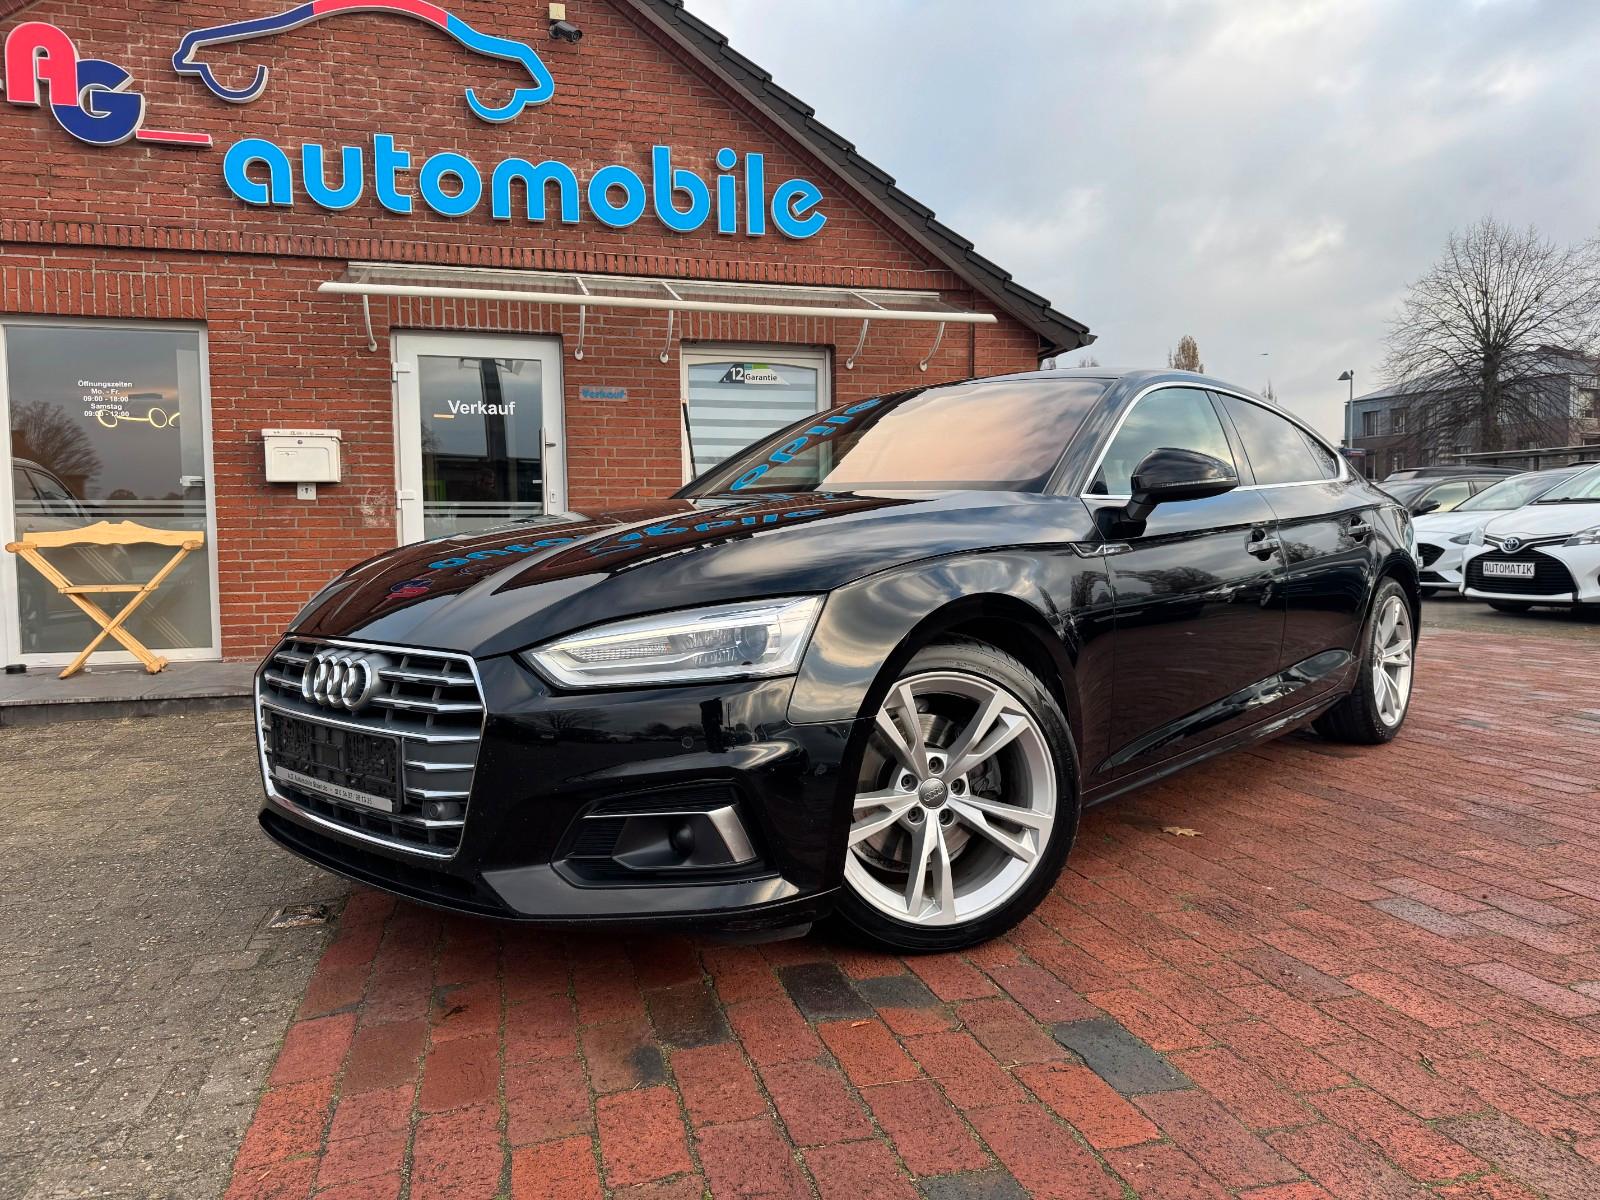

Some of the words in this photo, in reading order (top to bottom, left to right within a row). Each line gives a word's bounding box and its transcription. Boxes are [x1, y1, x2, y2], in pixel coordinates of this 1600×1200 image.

[5, 22, 145, 146] AG
[223, 133, 828, 240] automobile
[730, 368, 744, 380] 12
[78, 380, 133, 388] Öffnungszeiten
[447, 399, 516, 416] Verkauf
[1484, 563, 1533, 575] AUTOMATIK
